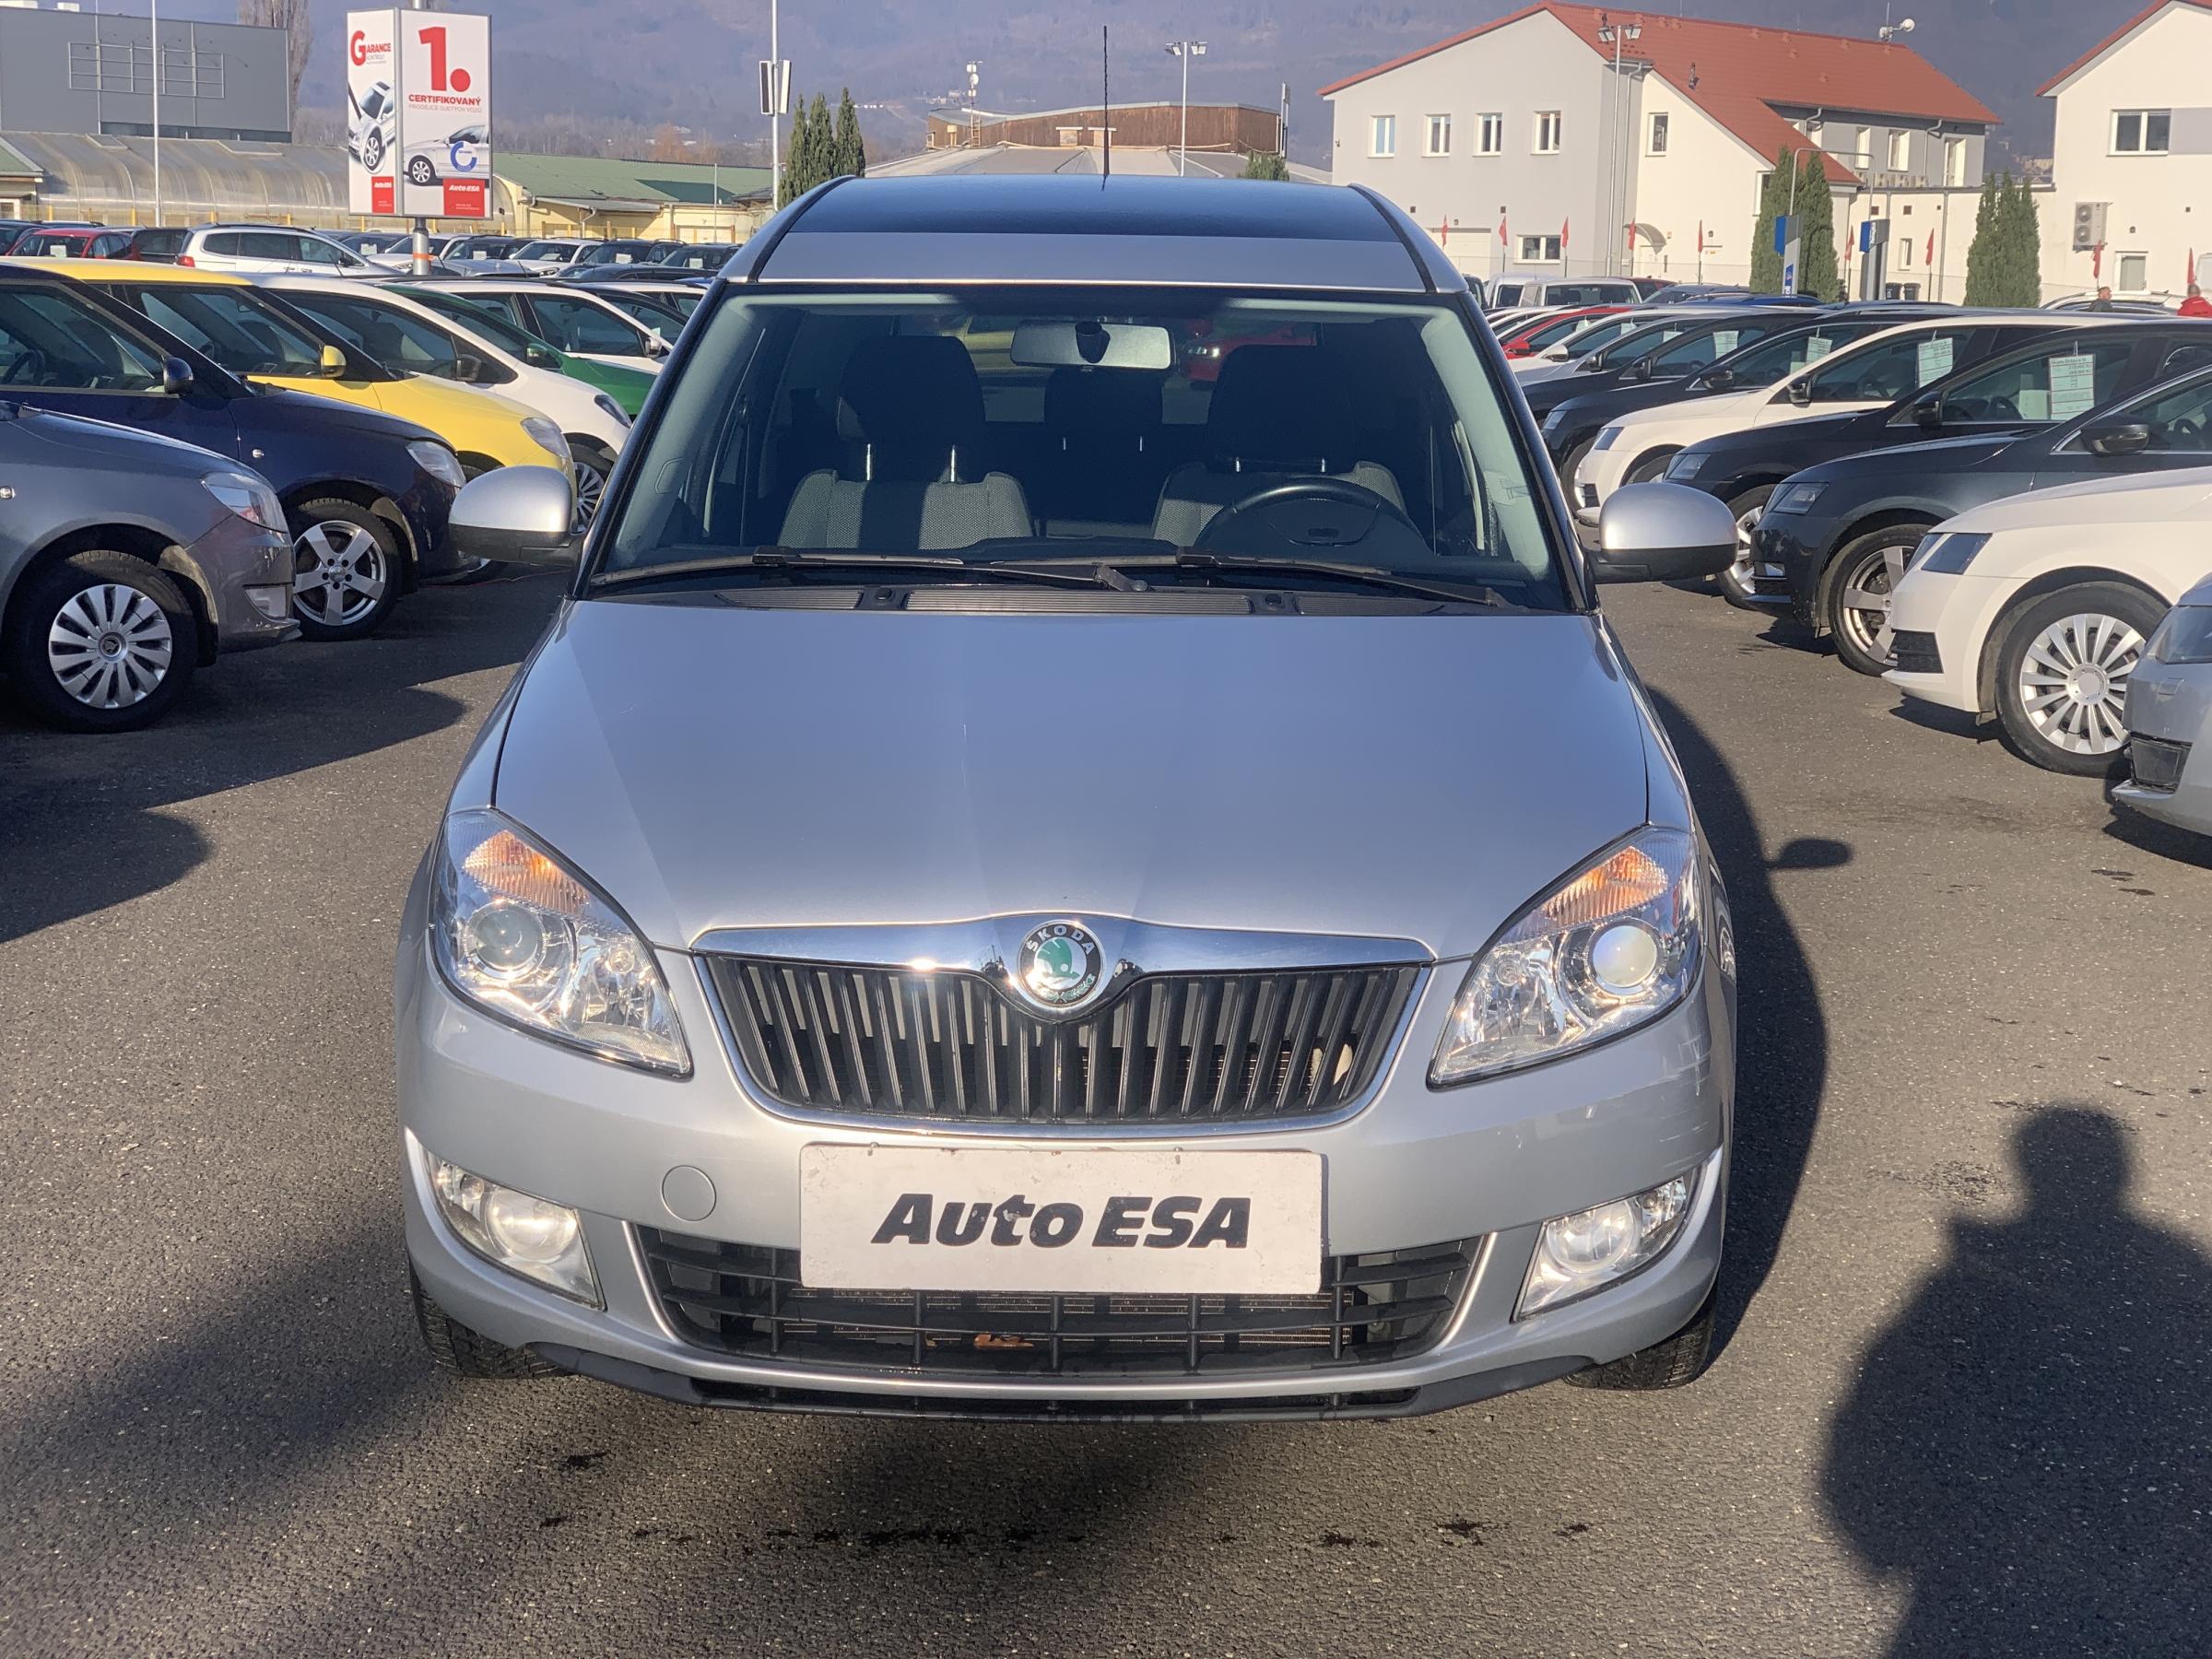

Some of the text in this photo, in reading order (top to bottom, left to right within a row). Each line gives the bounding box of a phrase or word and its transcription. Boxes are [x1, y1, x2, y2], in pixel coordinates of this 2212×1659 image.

[350, 29, 392, 66] GARANCE
[418, 26, 471, 93] 1.
[408, 94, 481, 106] CERTIFIKOVANÝ
[870, 1193, 1252, 1249] Auto ESA
